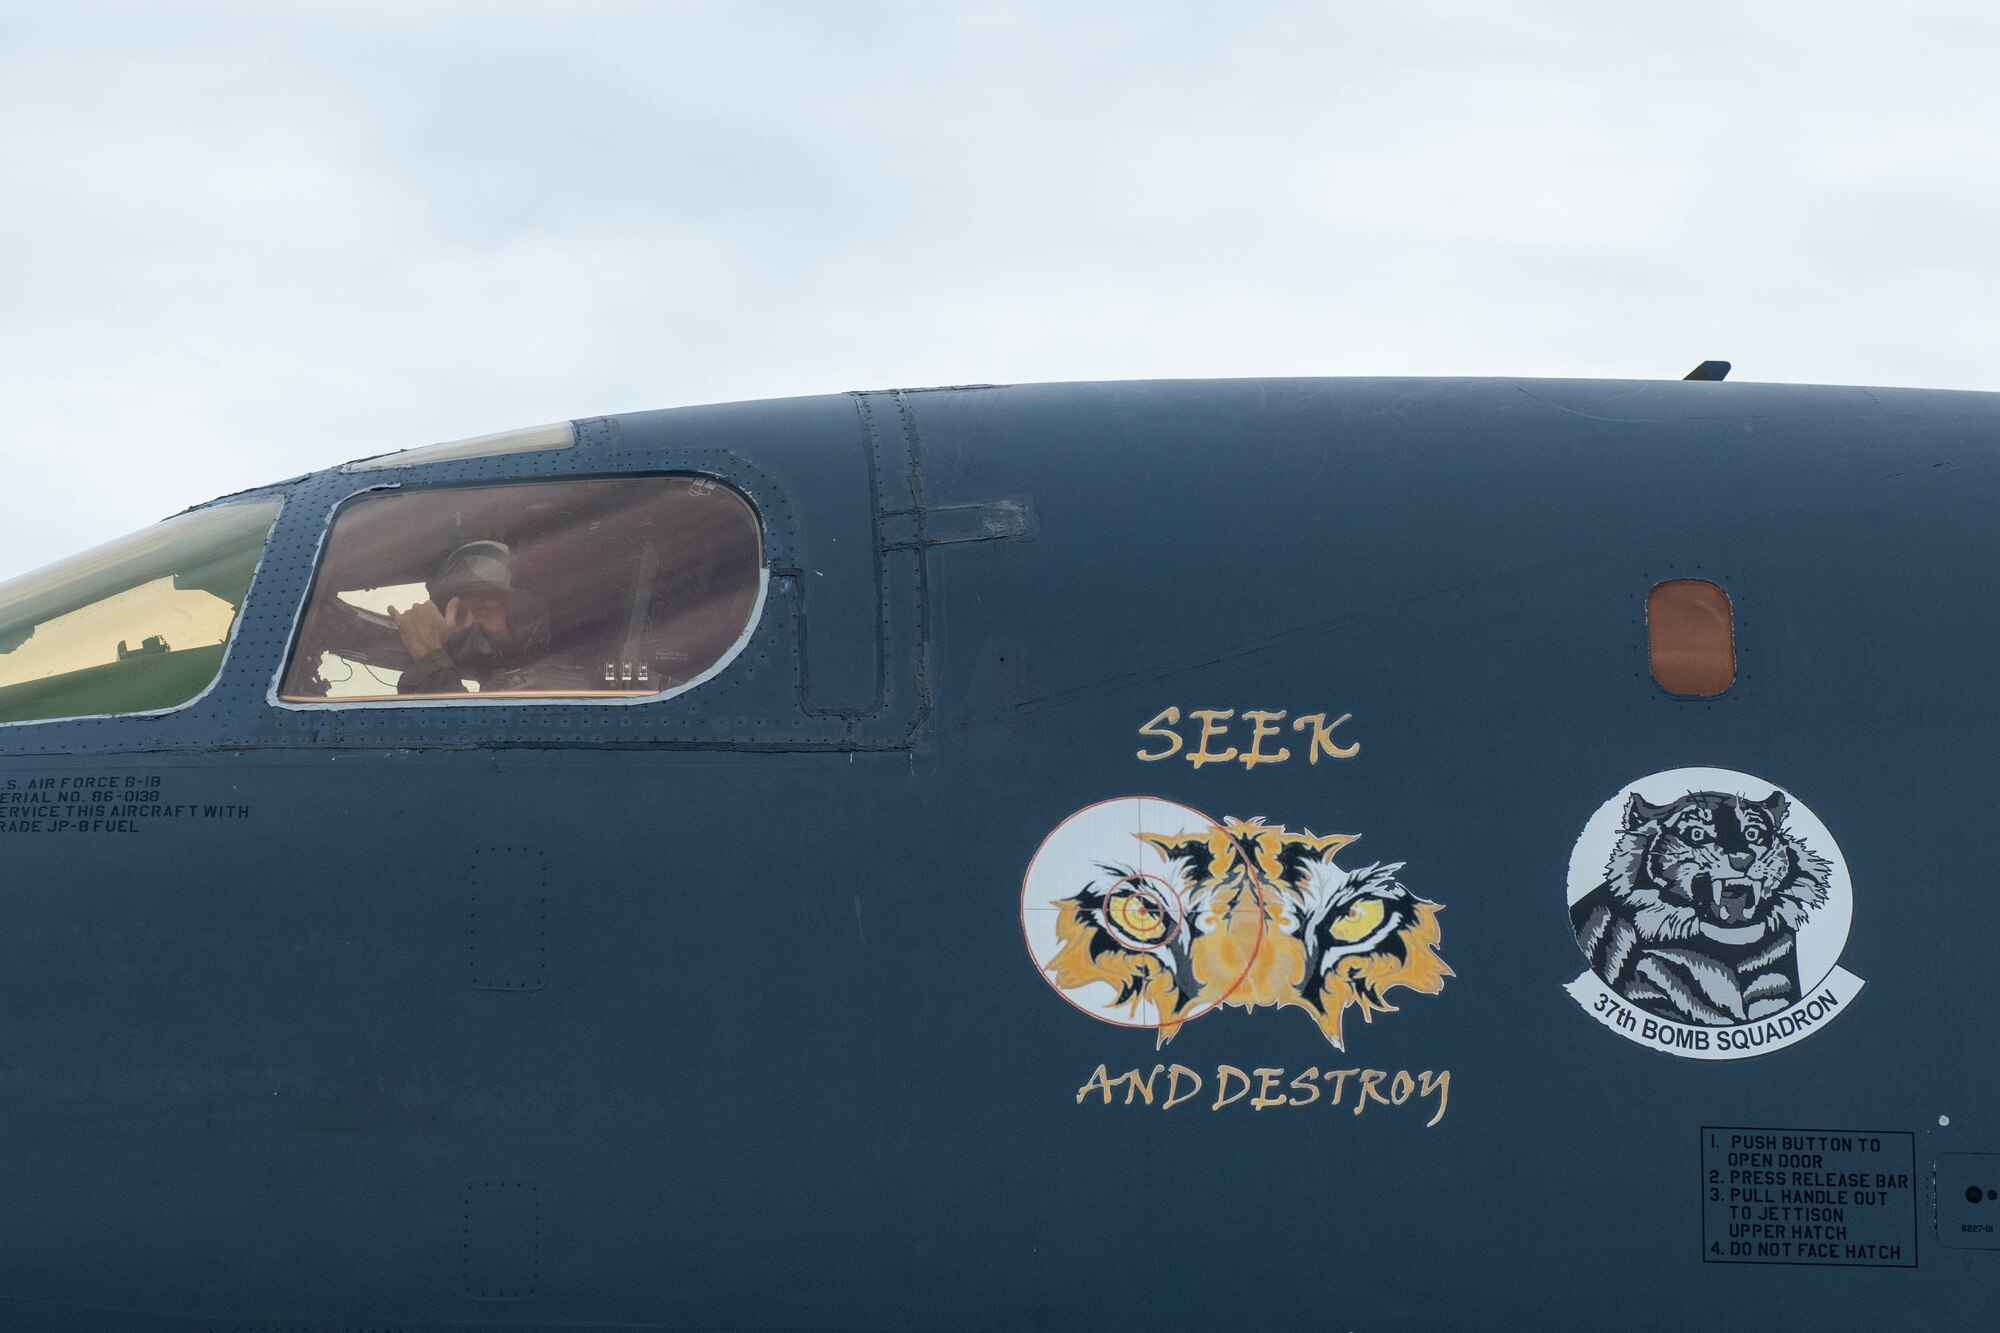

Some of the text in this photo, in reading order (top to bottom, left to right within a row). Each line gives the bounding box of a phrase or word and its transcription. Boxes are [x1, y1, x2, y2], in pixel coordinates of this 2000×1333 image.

[1136, 706, 1360, 770] SEEK
[28, 778, 56, 790] AIR
[60, 776, 120, 789] FORCE
[125, 776, 161, 788] B-1B
[0, 790, 160, 804] ERIAL NO. 86-0138
[0, 805, 249, 818] ERVICE THIS AIRCRAFT WITH
[0, 820, 139, 833] RADE JP-8 FUEL
[1593, 988, 1839, 1051] 37th BOMB SQUADRON
[1076, 1064, 1451, 1127] AND DESTROY
[1732, 1135, 1776, 1150] PUSH
[1783, 1136, 1851, 1152] BUTTON
[1858, 1138, 1880, 1153] TO
[1728, 1153, 1822, 1169] OPEN DOOR
[1709, 1170, 1908, 1189] 2. PRESS RELEASE BAR
[1709, 1188, 1888, 1206] 3. PULL HANDLE OUT
[1729, 1206, 1844, 1223] TO JETTISON
[1729, 1224, 1847, 1240] UPPER HATCH
[1710, 1241, 1901, 1260] 4. DO NOT FACE HATCH
